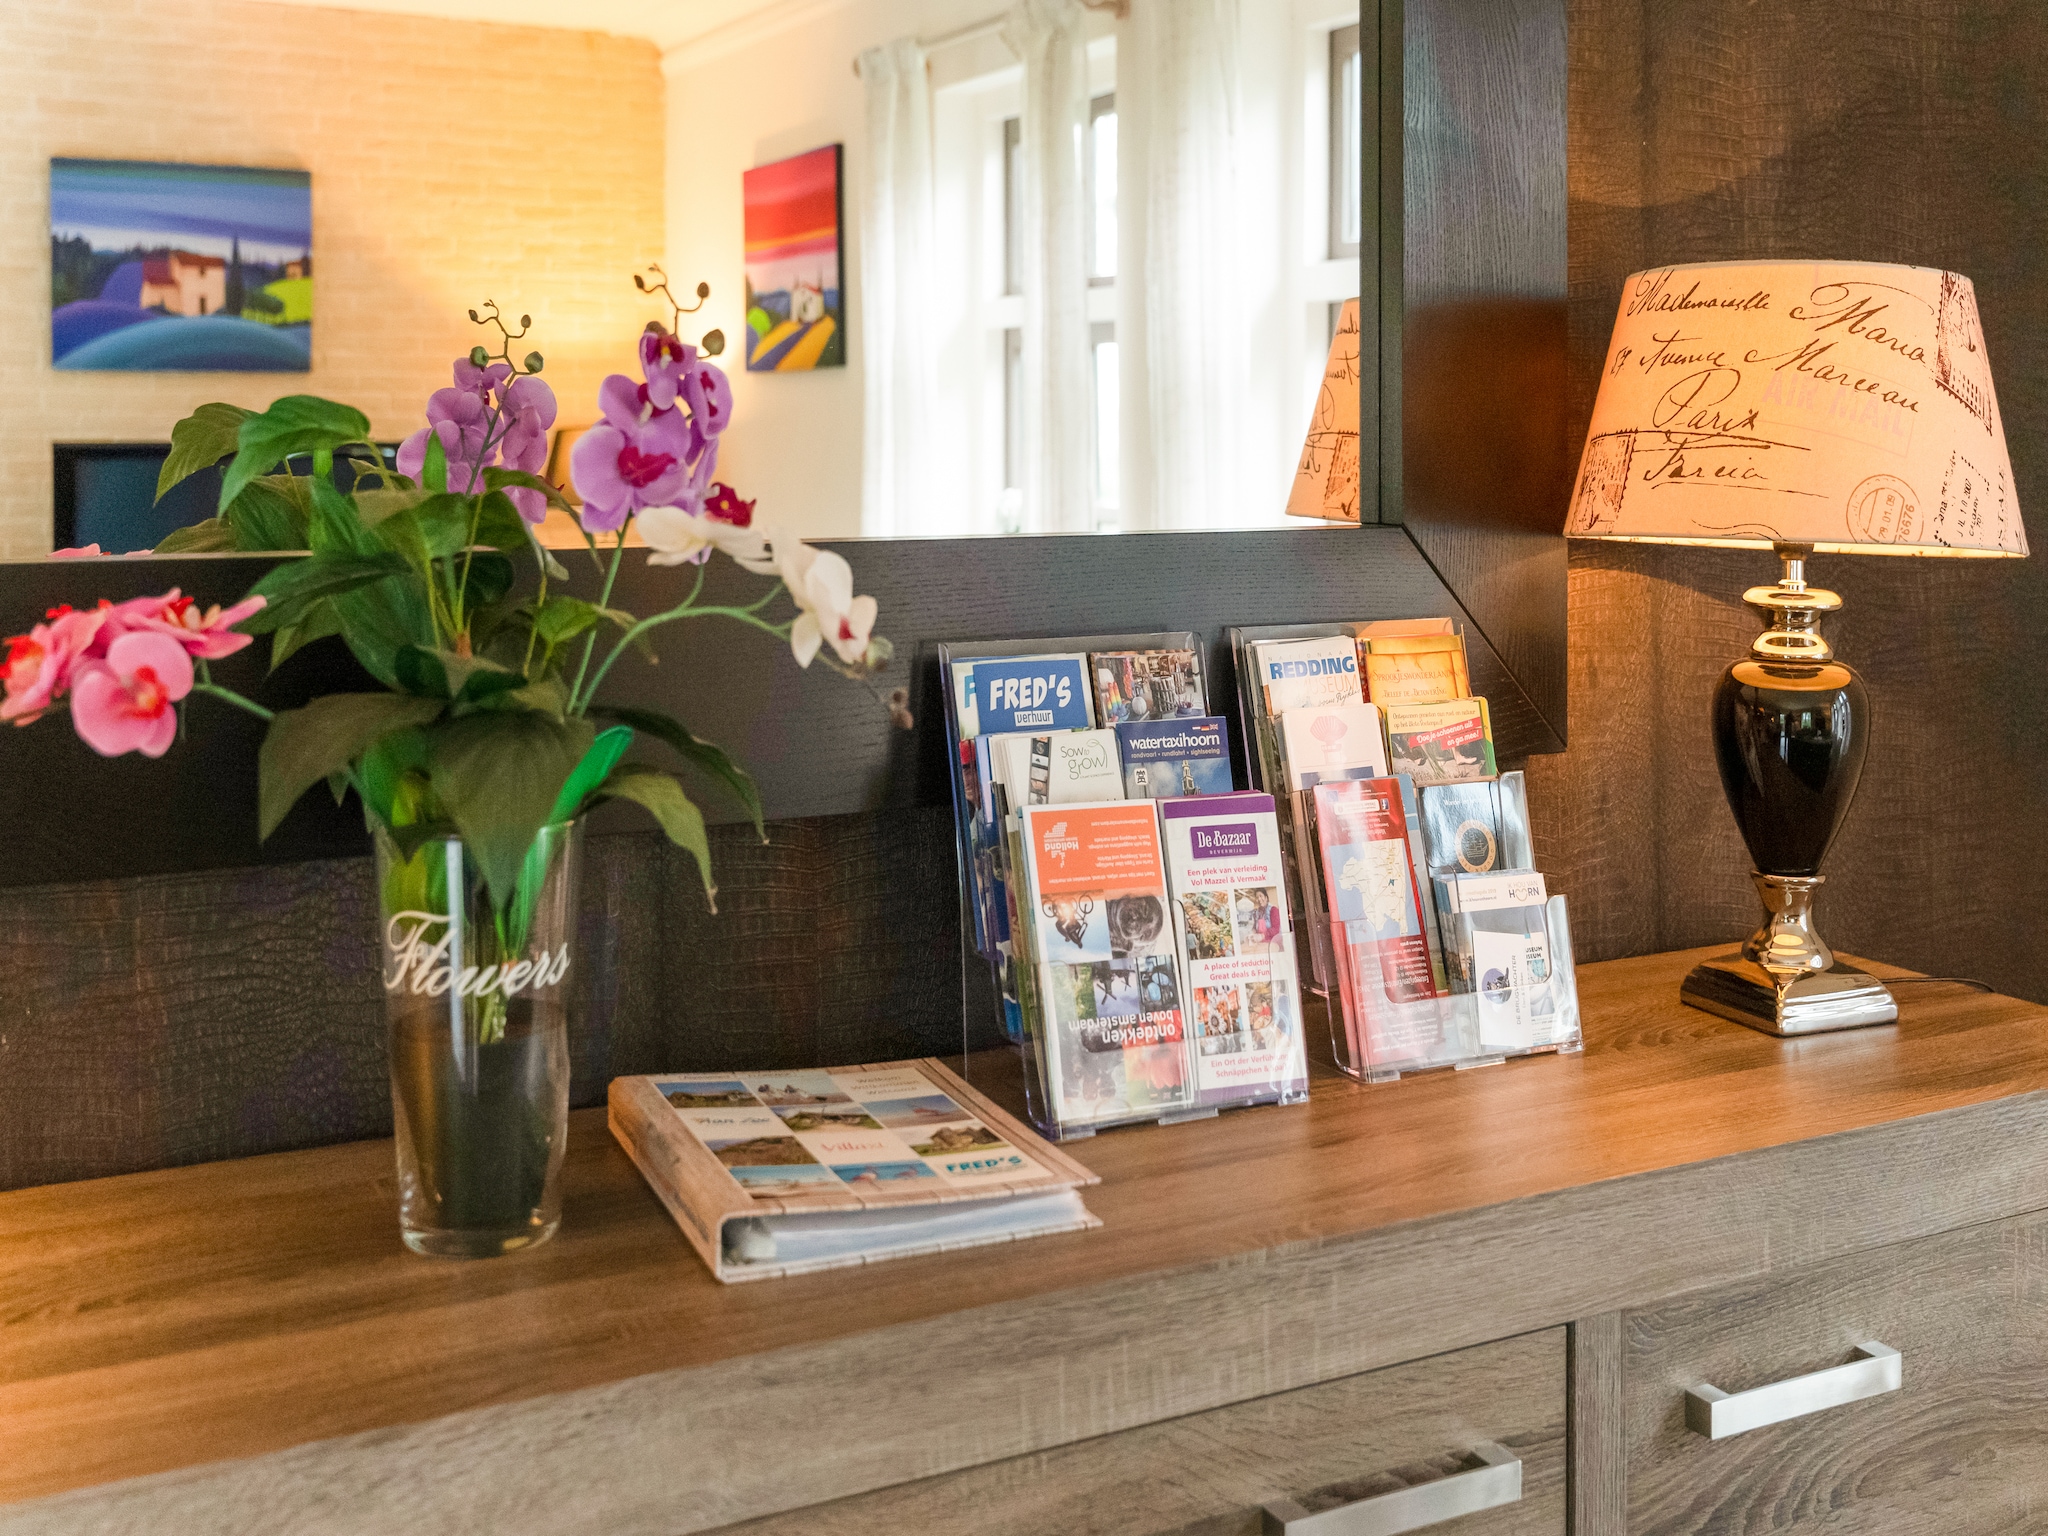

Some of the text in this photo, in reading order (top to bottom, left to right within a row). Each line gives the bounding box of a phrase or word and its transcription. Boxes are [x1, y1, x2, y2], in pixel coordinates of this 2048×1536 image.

[1269, 656, 1356, 679] REDDING
[989, 674, 1072, 711] FRED'S
[1016, 711, 1052, 724] verhuur
[1416, 720, 1474, 743] Doe je schoenen uit
[1455, 737, 1465, 746] ga
[1465, 730, 1479, 740] mee!
[1129, 733, 1220, 750] watertaxihoorn
[1068, 757, 1108, 780] grow
[1045, 842, 1079, 852] Holland
[1197, 830, 1251, 848] De Bazaar
[1187, 869, 1201, 877] Een
[1202, 866, 1218, 877] plek
[1233, 864, 1268, 873] verleiding
[1191, 878, 1203, 886] Vol
[1204, 876, 1229, 885] Mazzel
[1236, 874, 1266, 882] Vermaak
[383, 909, 571, 998] Flowers
[1211, 962, 1230, 972] place
[1232, 961, 1239, 969] of
[1241, 959, 1274, 968] seduction
[1209, 972, 1230, 981] Great
[1231, 970, 1250, 979] deals
[1251, 969, 1256, 977] &
[1068, 1009, 1174, 1031] boven amsterdam
[1102, 1024, 1176, 1046] ontdekken
[1211, 1060, 1223, 1068] Ein
[1224, 1058, 1236, 1066] Ort
[1237, 1057, 1249, 1065] der
[1216, 1066, 1262, 1078] Schnäppchen
[946, 1156, 1022, 1172] FRED'S
